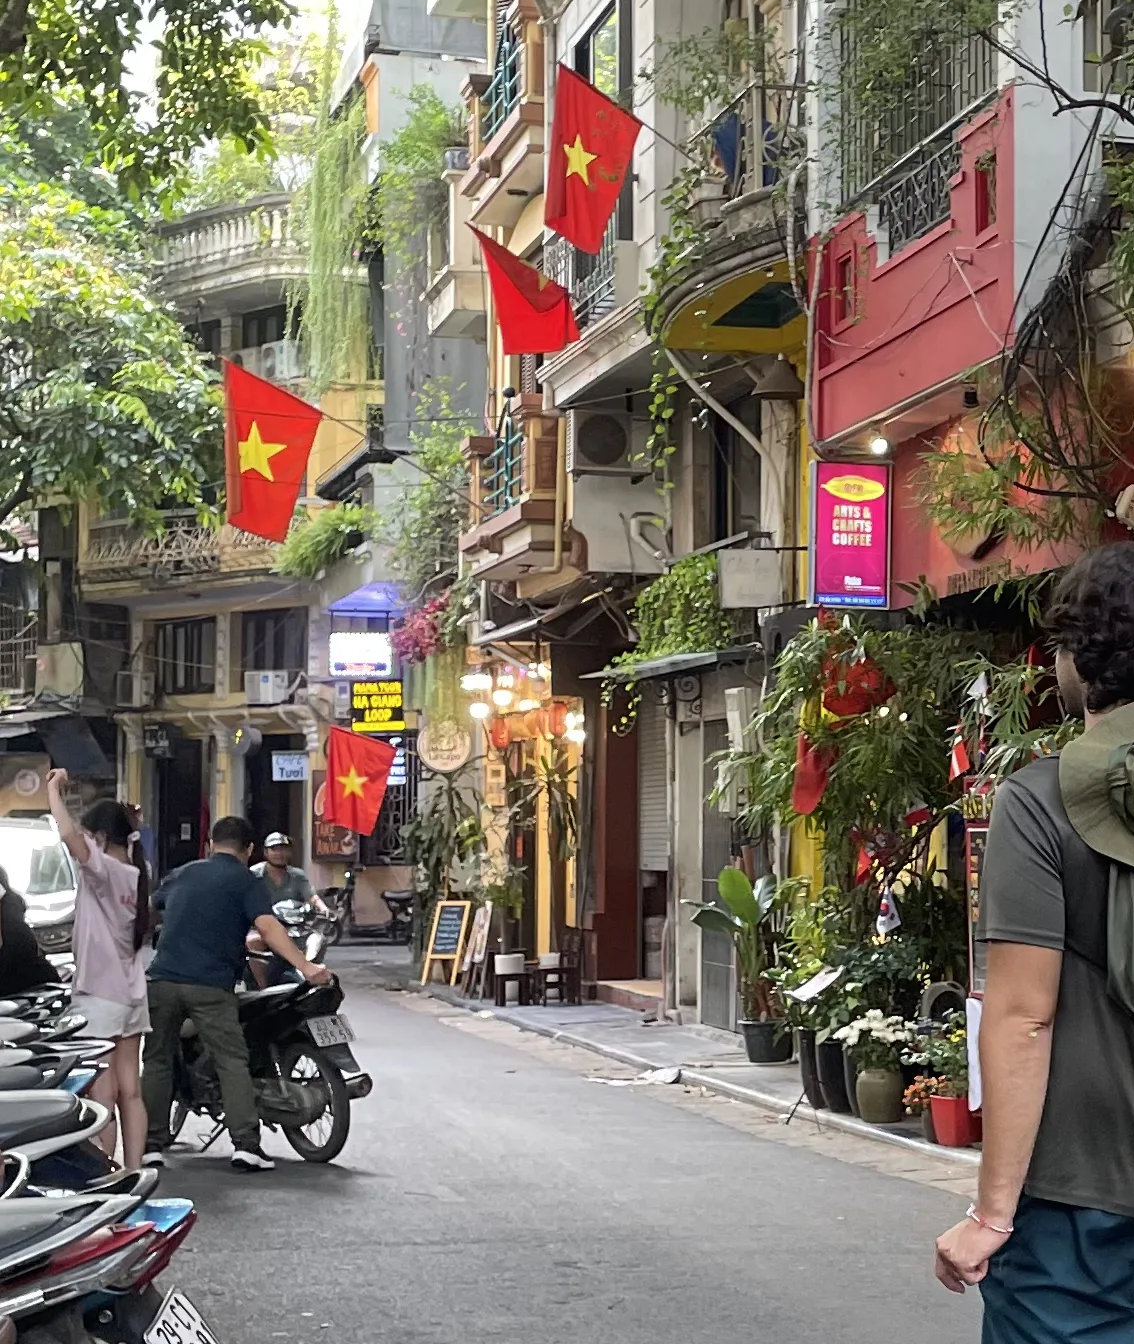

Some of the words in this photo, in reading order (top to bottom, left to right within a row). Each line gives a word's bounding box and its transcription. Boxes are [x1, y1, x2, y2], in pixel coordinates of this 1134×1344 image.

[833, 505, 861, 518] ARTS
[863, 506, 871, 519] &
[832, 518, 872, 533] CRAFTS
[832, 532, 872, 547] COFFEE
[370, 695, 402, 708] GIANG
[365, 708, 392, 722] LOOP
